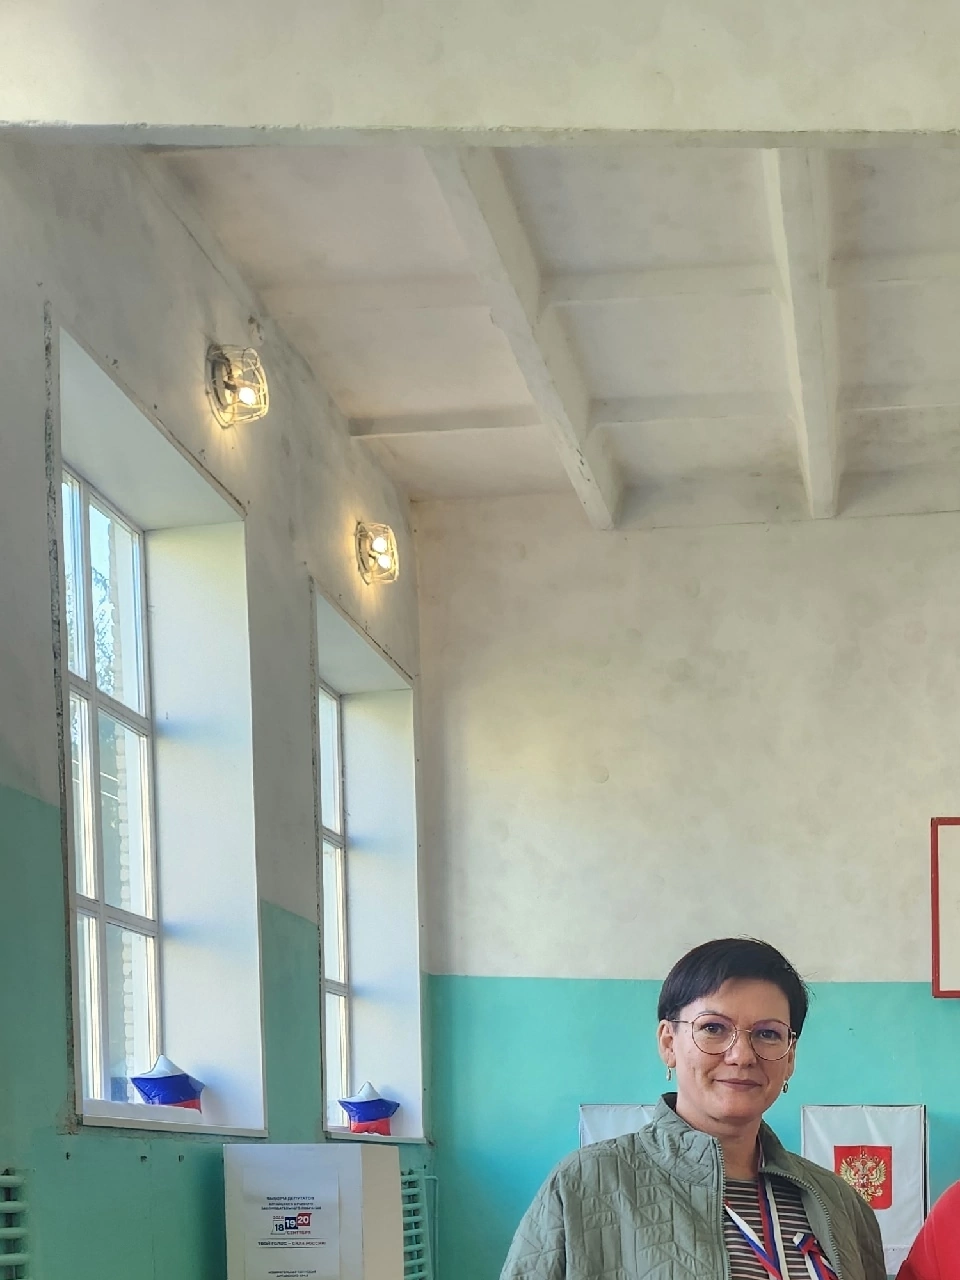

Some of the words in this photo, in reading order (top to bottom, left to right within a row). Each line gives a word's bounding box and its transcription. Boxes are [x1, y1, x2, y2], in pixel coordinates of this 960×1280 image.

[274, 1223, 285, 1232] 18
[285, 1219, 296, 1228] 19
[297, 1215, 309, 1224] 20
